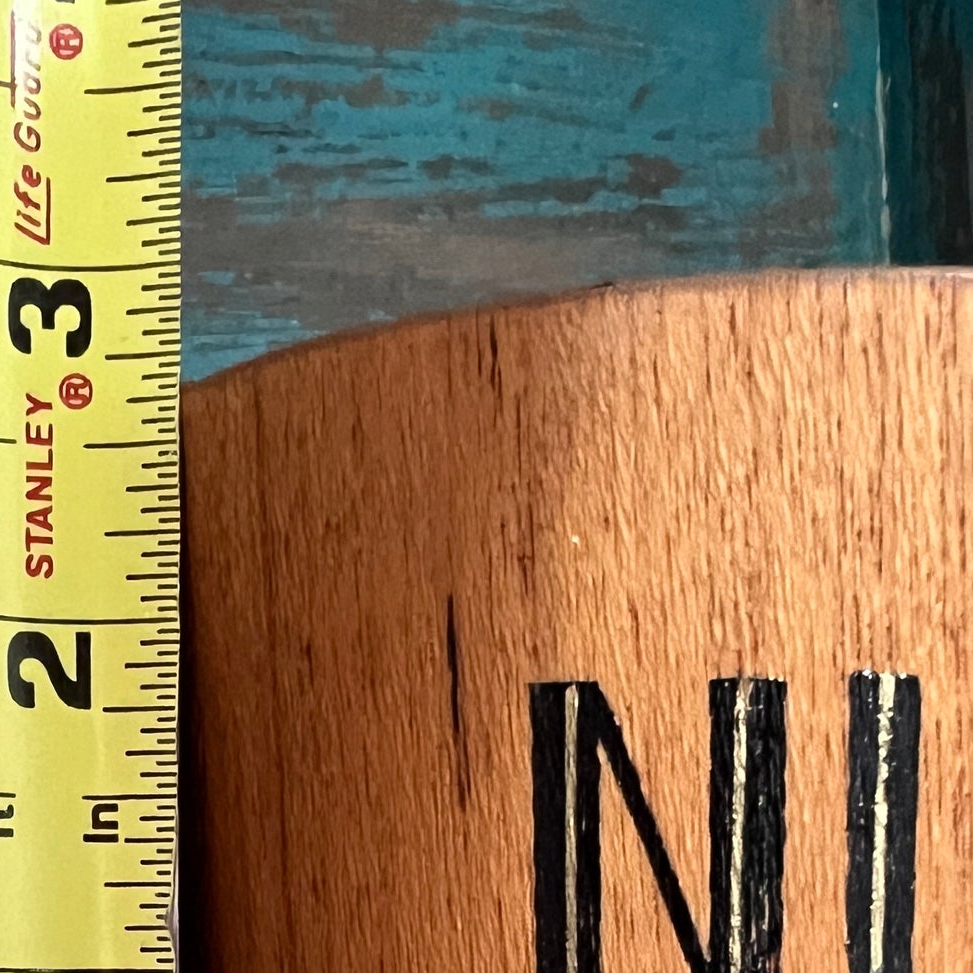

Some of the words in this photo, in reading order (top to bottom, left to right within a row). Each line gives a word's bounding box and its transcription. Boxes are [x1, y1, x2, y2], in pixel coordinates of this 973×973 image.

[14, 165, 51, 245] Life
[8, 277, 93, 358] 3
[25, 393, 53, 579] STANLEY
[7, 631, 92, 710] 2
